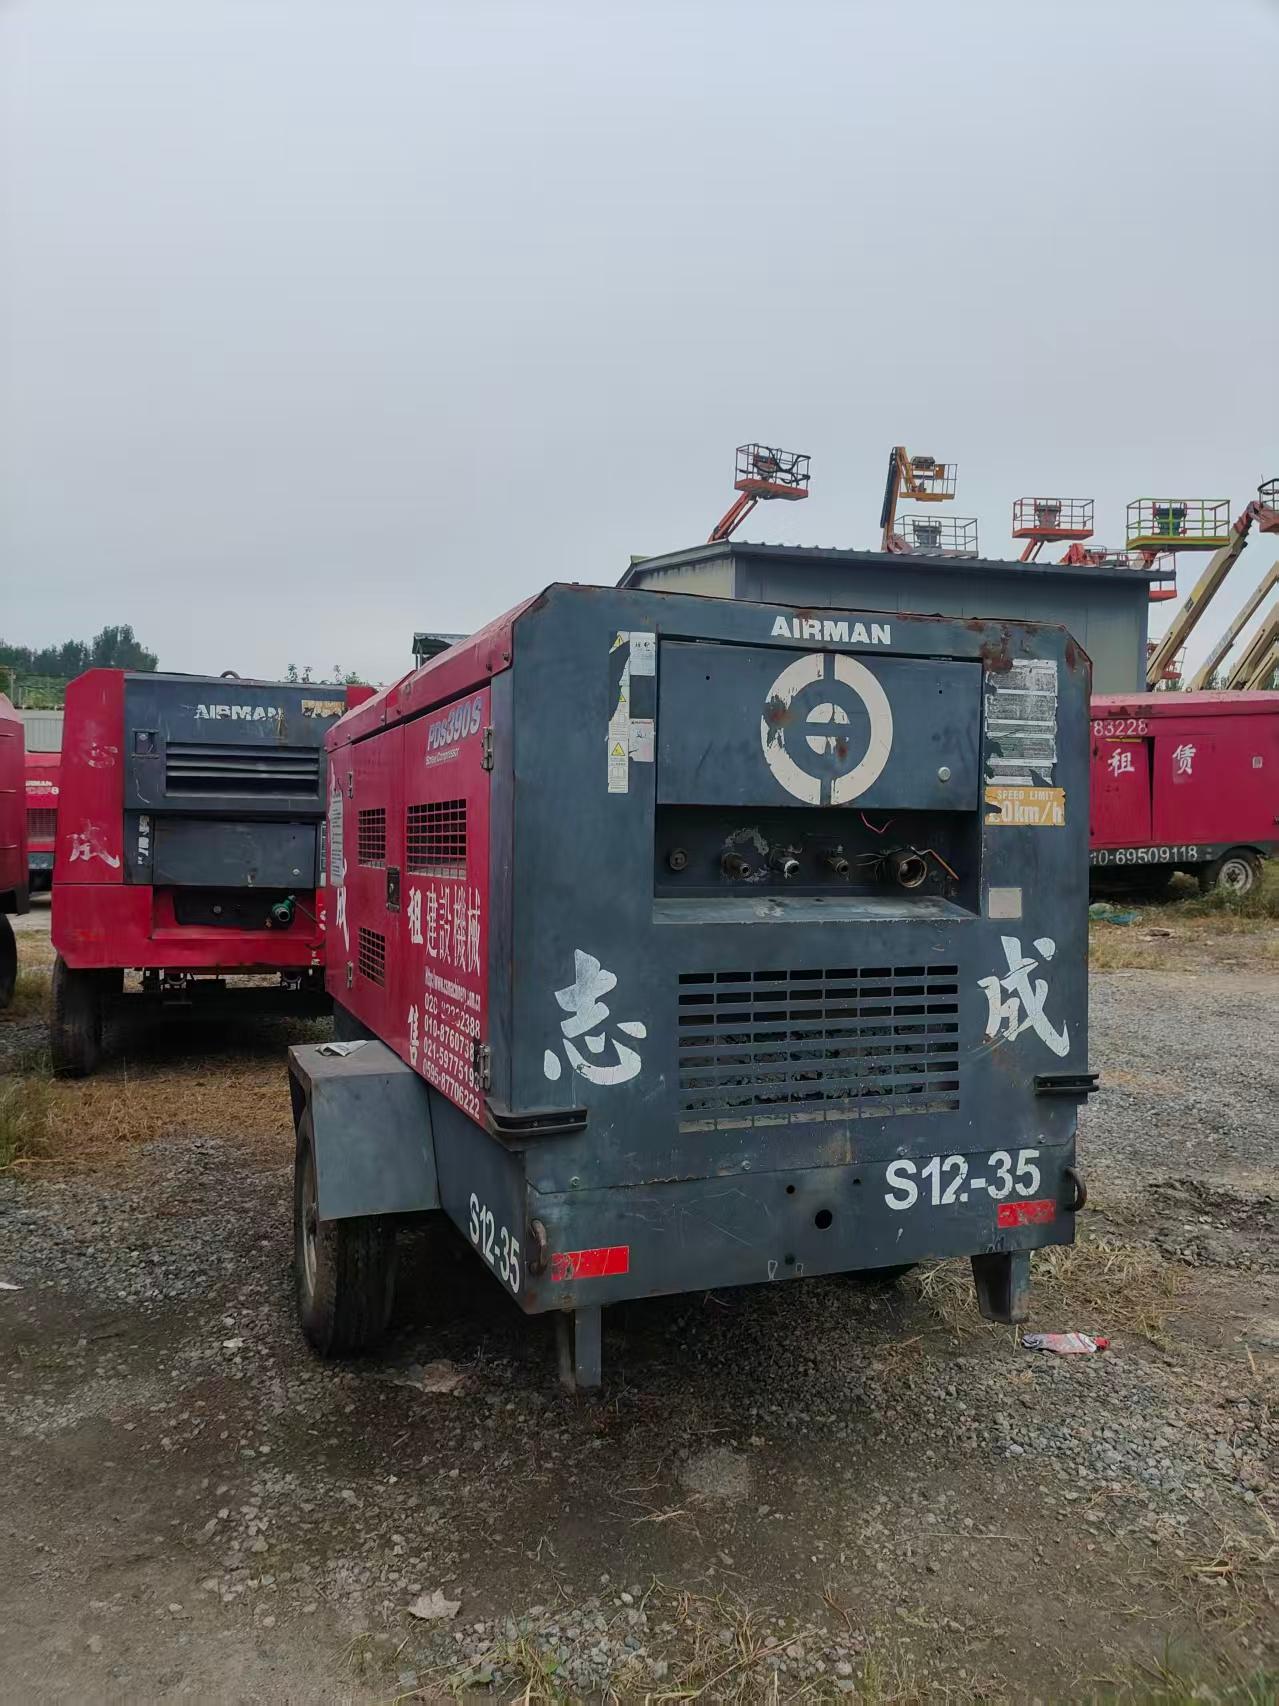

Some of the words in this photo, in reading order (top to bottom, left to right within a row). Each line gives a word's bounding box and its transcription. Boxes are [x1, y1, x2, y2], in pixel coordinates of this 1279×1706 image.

[770, 615, 891, 645] AIRMAN
[428, 696, 482, 751] PDS390S
[1090, 719, 1148, 736] 83228
[1107, 748, 1135, 777] 租
[1172, 744, 1197, 775] 赁
[996, 790, 1025, 800] SPEED
[1029, 791, 1055, 801] LIMIT
[426, 882, 481, 977] 建設機械
[543, 948, 647, 1086] 志
[976, 935, 1070, 1058] 成
[424, 1014, 480, 1063] 010-8760738
[469, 1192, 520, 1294] S12-35
